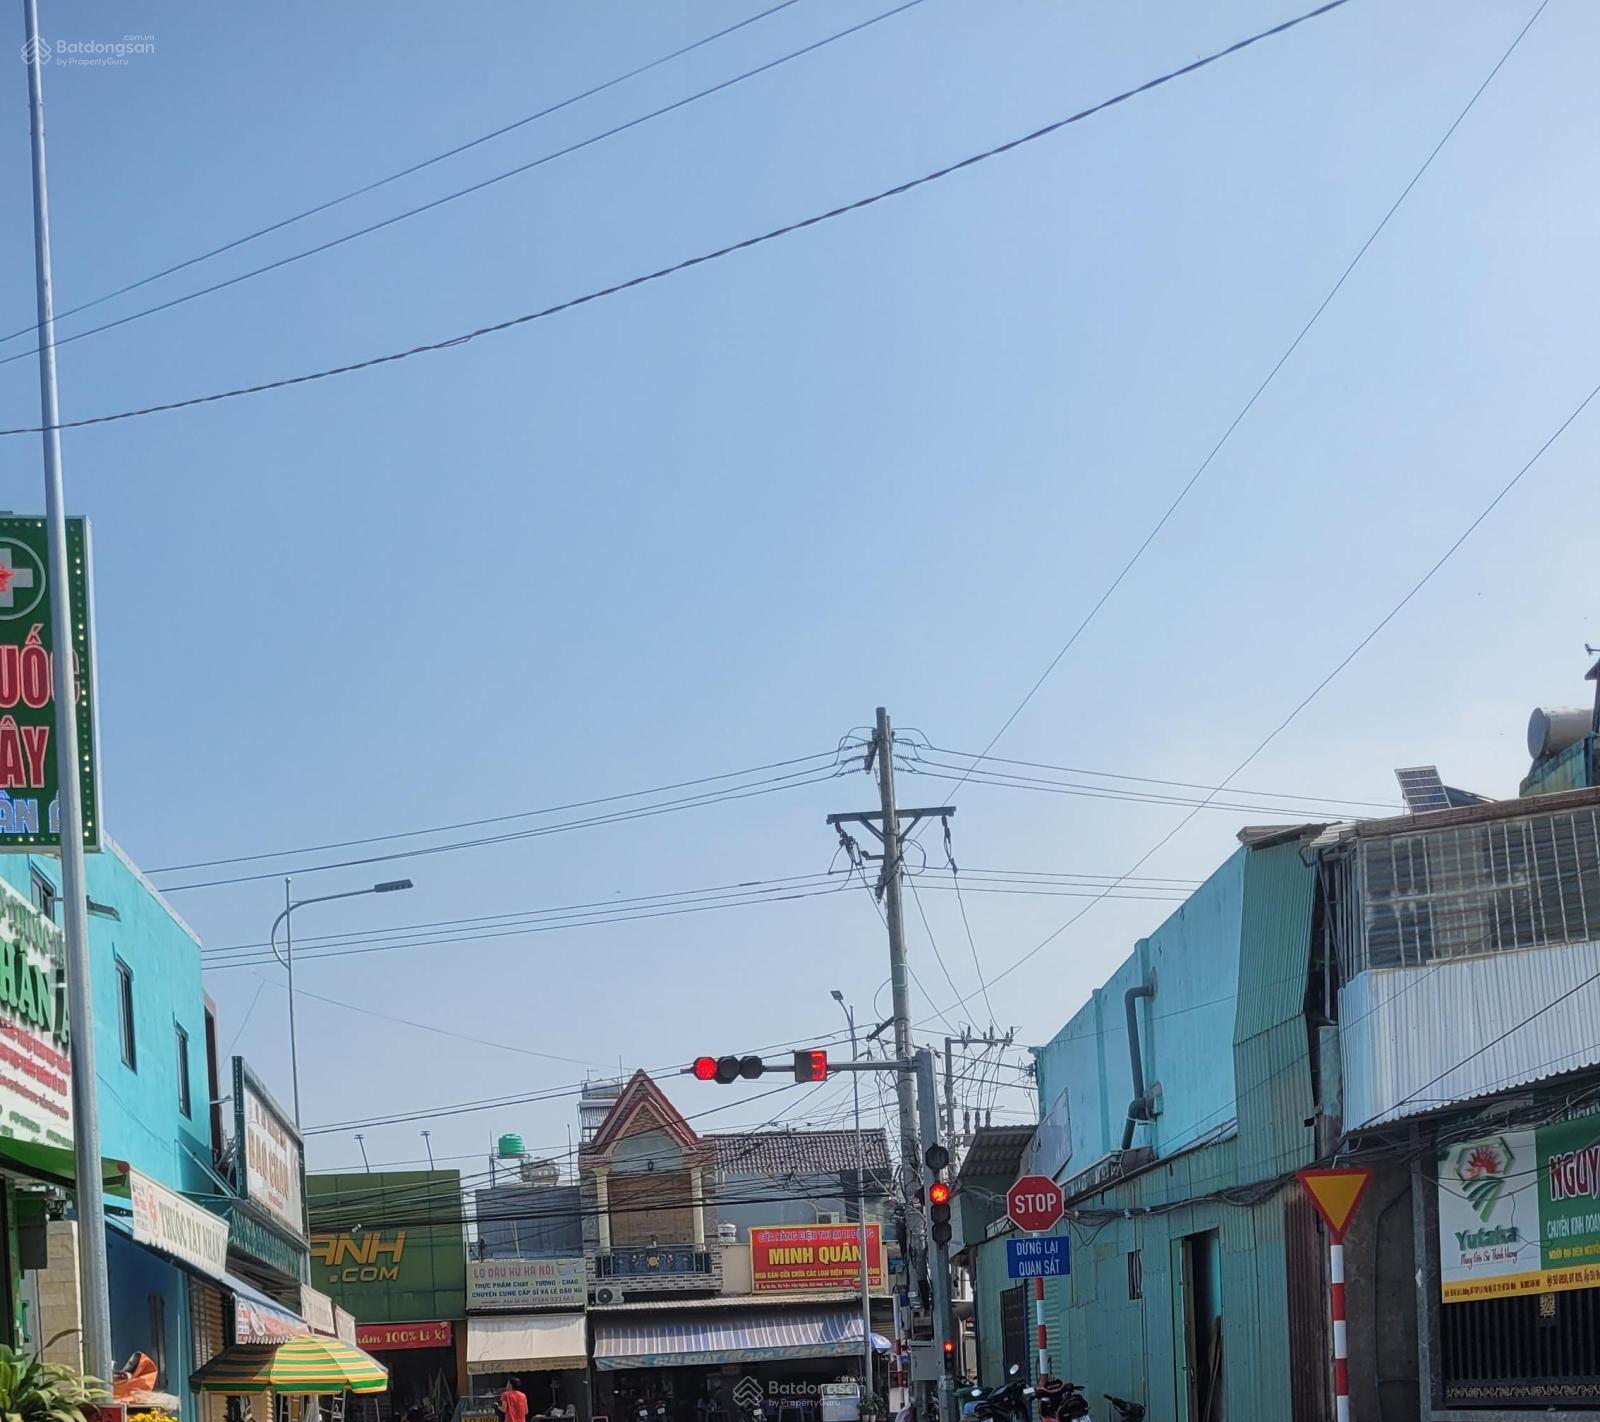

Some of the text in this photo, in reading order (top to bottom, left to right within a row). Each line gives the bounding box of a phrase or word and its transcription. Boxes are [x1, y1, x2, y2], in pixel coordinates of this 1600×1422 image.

[1015, 1193, 1057, 1213] STOP
[769, 1242, 862, 1265] MINH QUÂN
[1045, 1240, 1059, 1254] LẠI
[329, 1266, 399, 1283] .COM
[1018, 1256, 1061, 1276] QUAN SÁT
[385, 1331, 417, 1343] 100%
